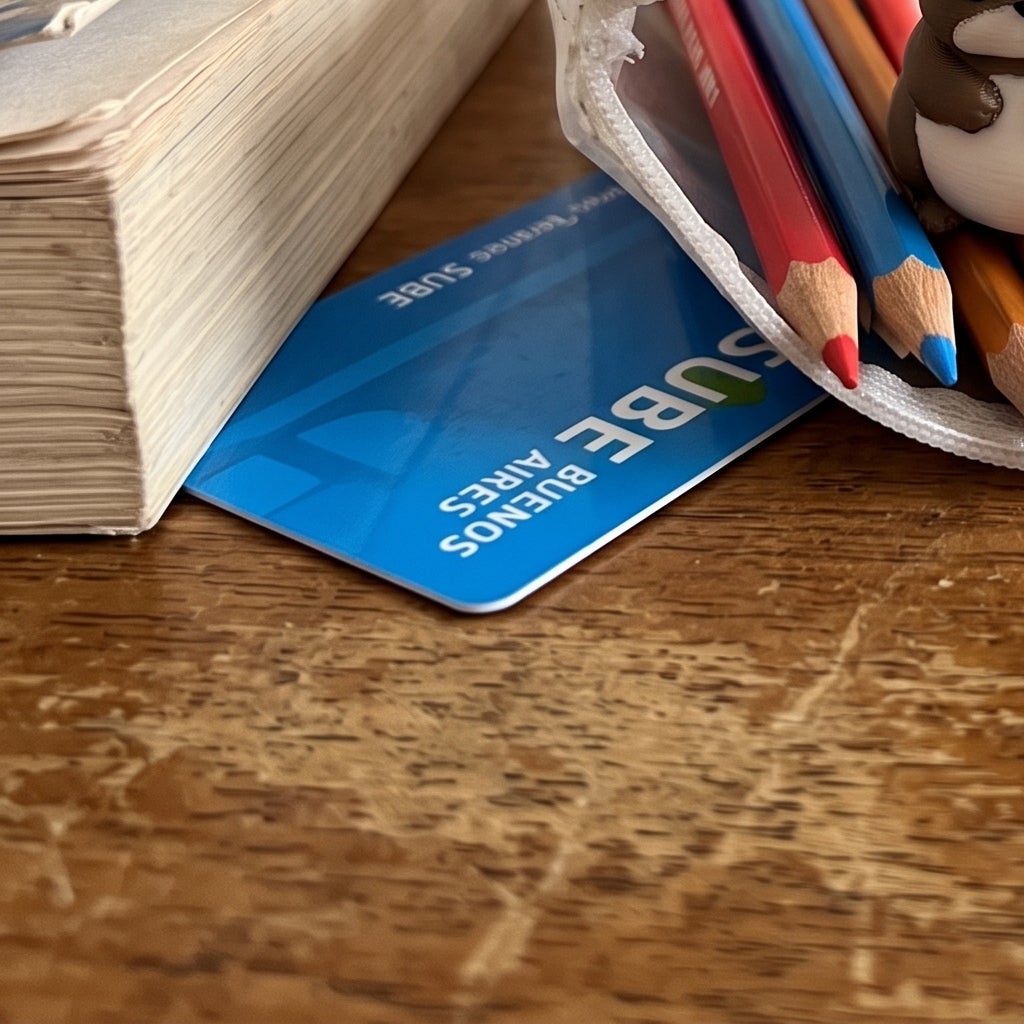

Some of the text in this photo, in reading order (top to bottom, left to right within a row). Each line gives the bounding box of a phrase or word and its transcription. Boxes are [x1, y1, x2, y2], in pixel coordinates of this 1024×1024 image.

[378, 262, 474, 308] SUBE
[554, 327, 789, 464] SUBE
[439, 448, 551, 518] AIRES
[439, 464, 598, 558] BUENOS
